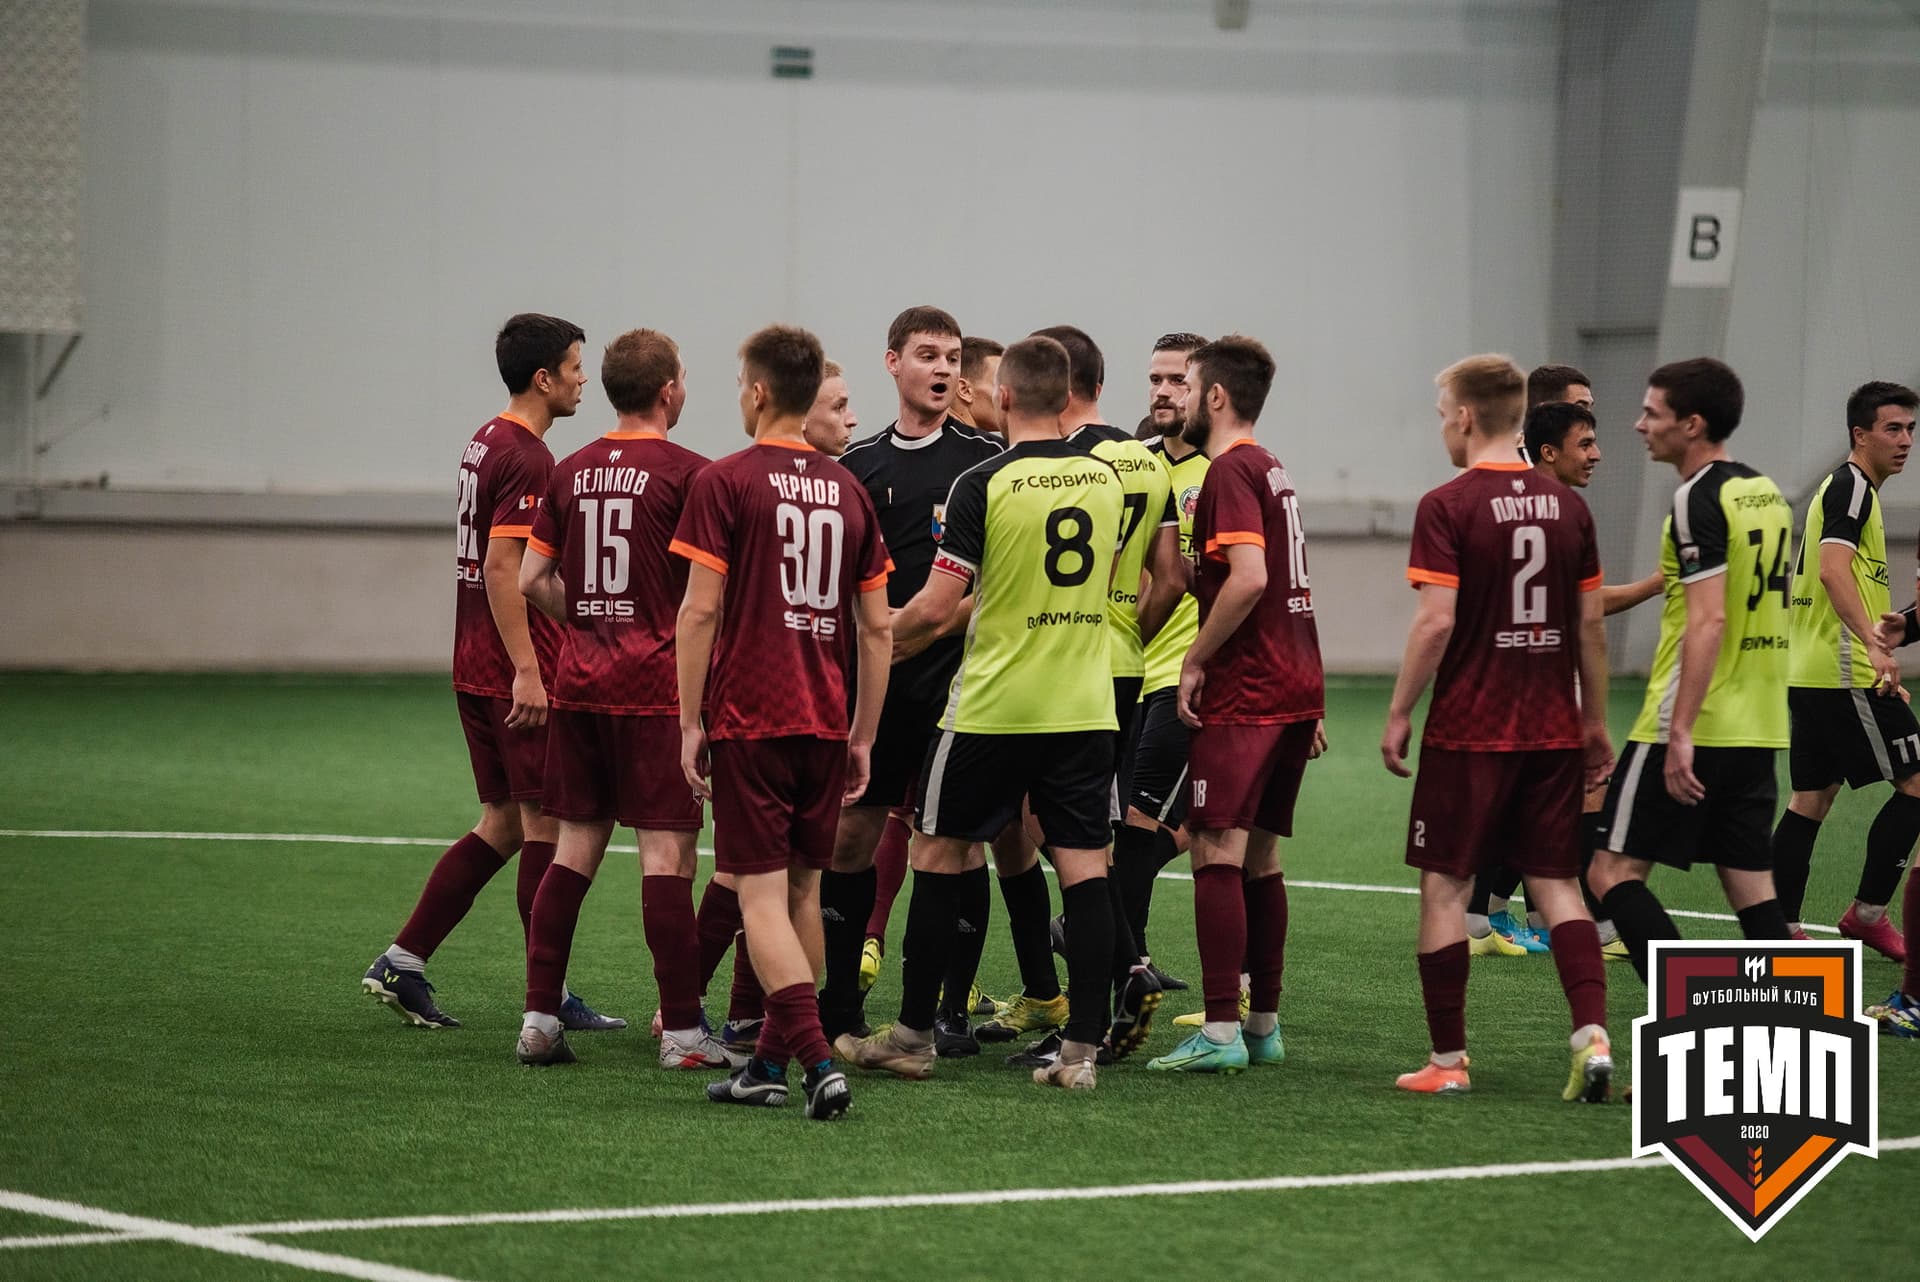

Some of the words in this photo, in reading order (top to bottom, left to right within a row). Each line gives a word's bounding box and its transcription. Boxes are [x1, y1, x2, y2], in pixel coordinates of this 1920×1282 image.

[573, 467, 650, 496] БЕЛИКОВ
[768, 472, 840, 507] ЧЕРНОВ
[1027, 471, 1108, 490] сервико
[579, 498, 633, 594] 15
[776, 502, 844, 610] 30
[1044, 506, 1095, 587] 8
[1512, 525, 1547, 625] 2
[576, 600, 634, 616] SEUS
[1113, 590, 1137, 603] Gro
[1287, 595, 1313, 614] SEU
[1892, 733, 1920, 764] 11
[1192, 779, 1207, 808] 18
[1414, 820, 1425, 848] 2
